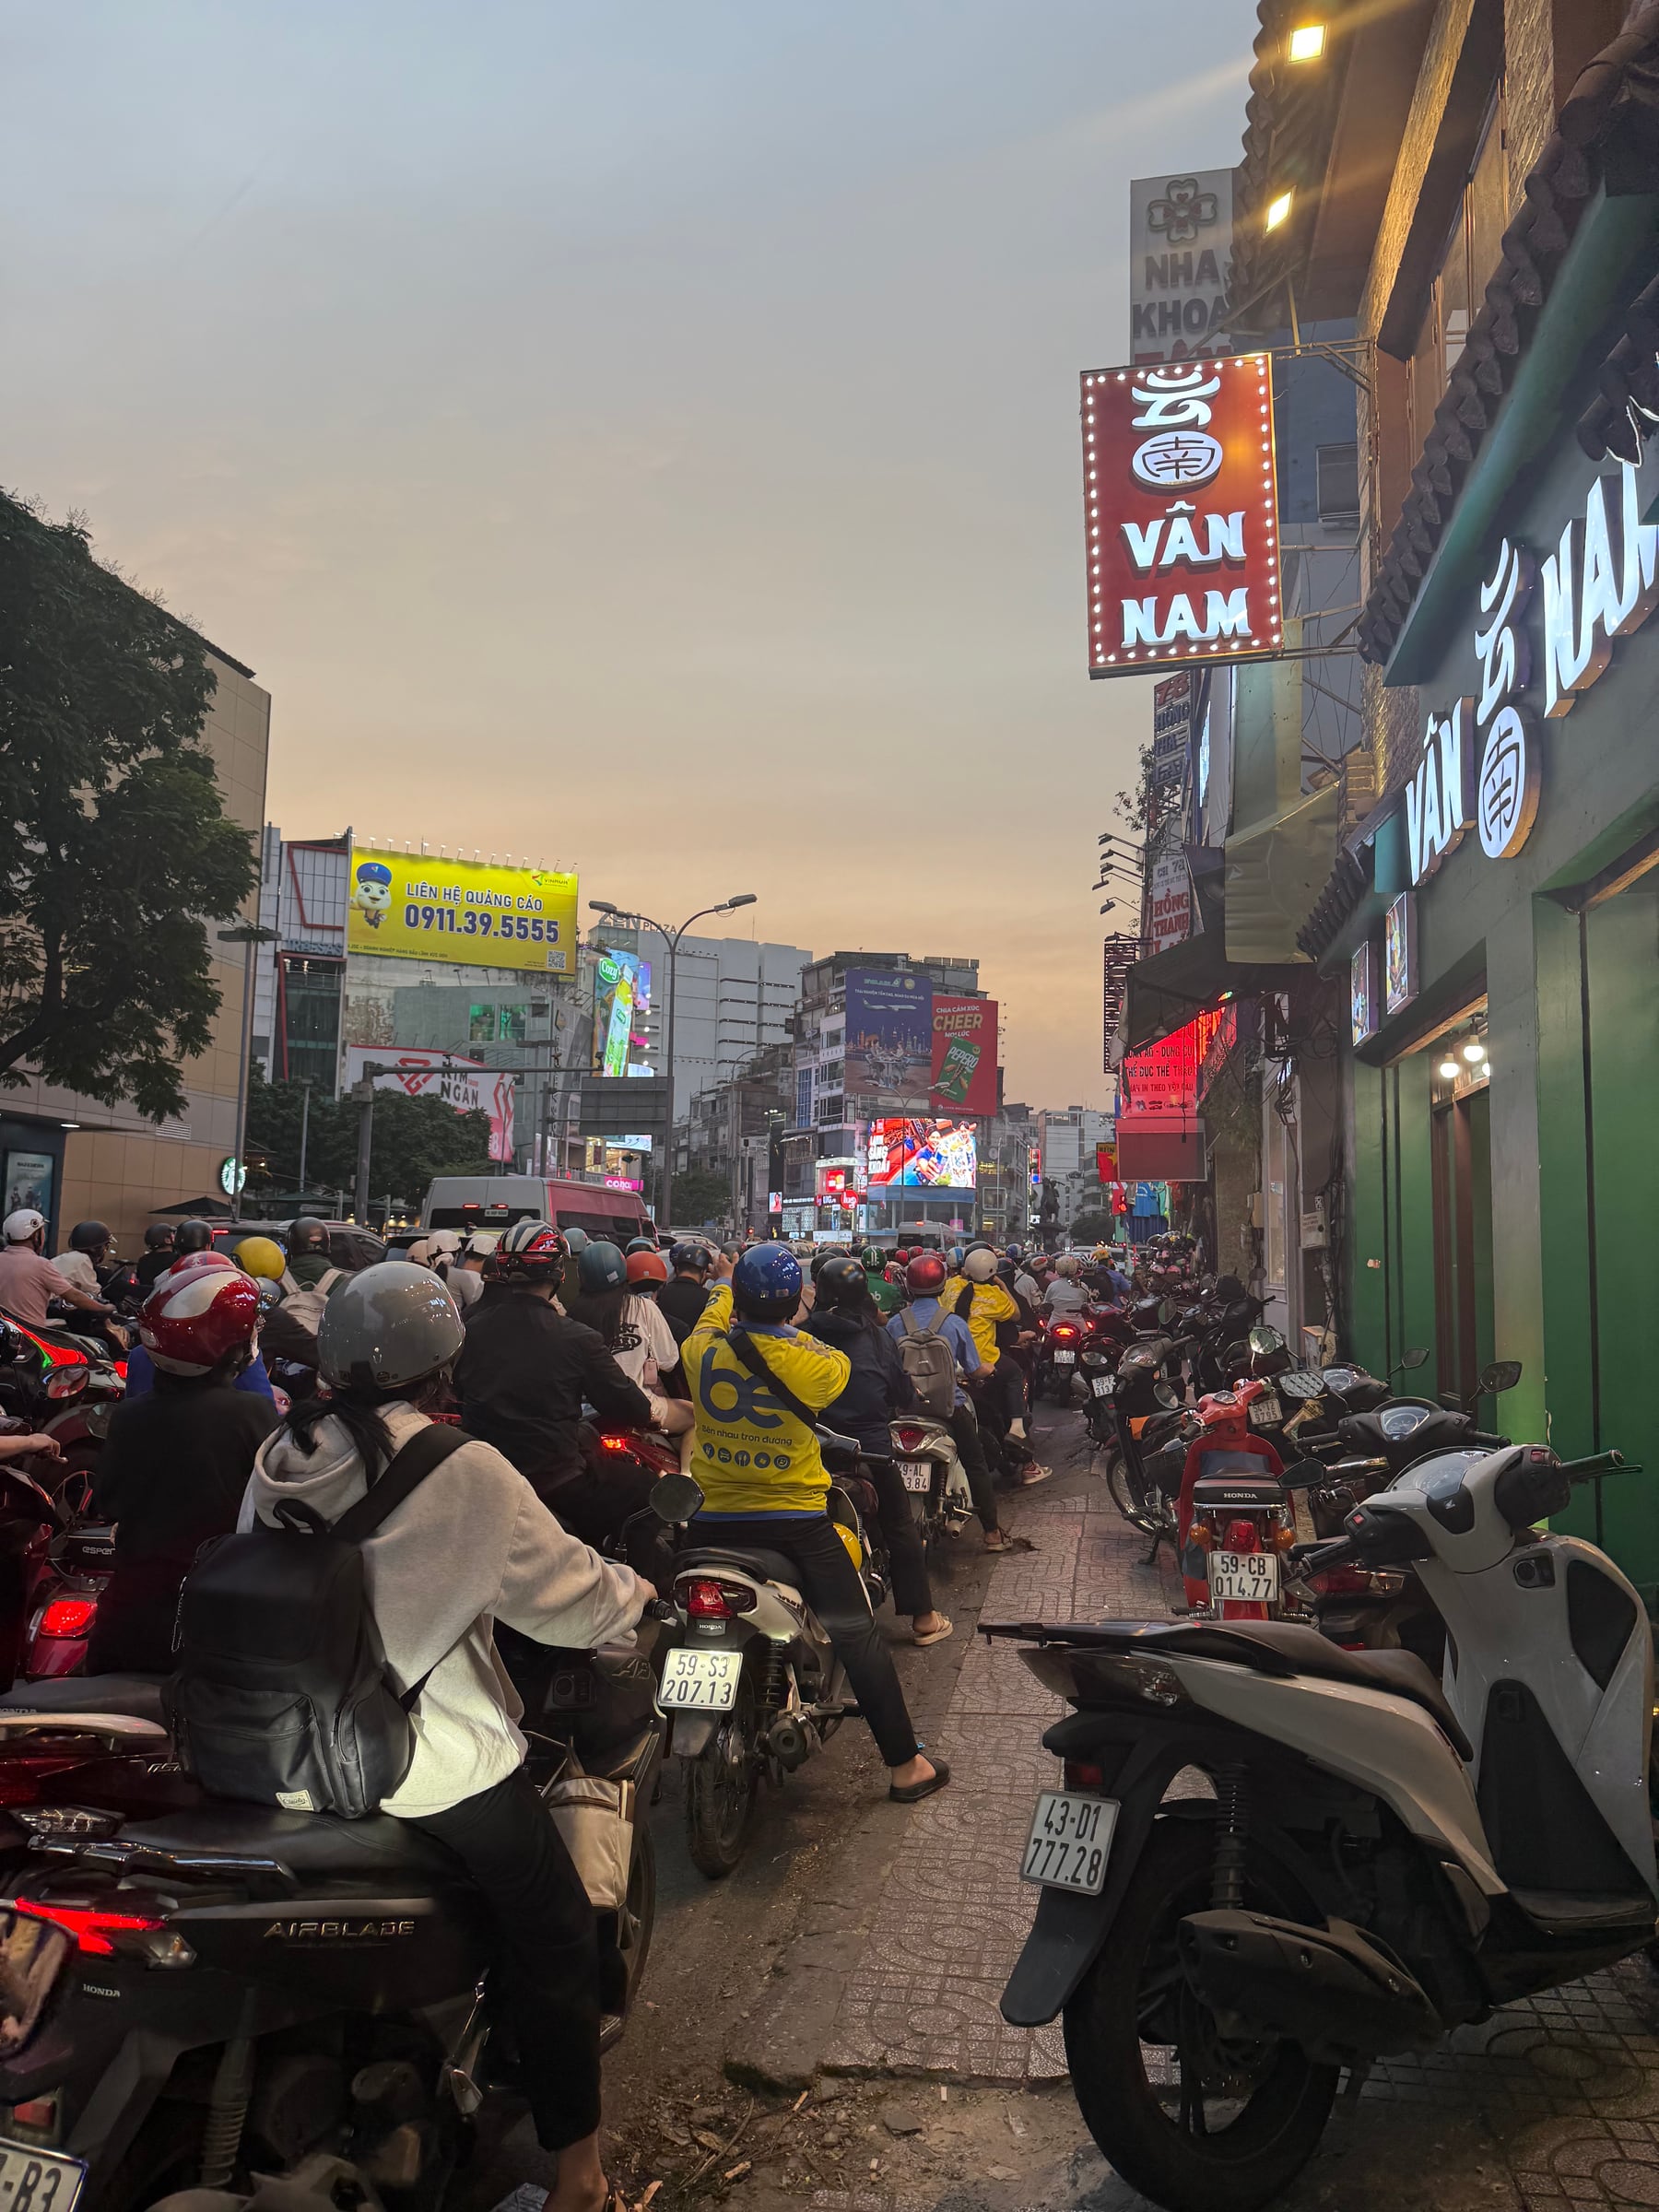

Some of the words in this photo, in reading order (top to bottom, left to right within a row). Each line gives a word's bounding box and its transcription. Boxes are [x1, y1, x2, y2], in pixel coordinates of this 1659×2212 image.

[1145, 249, 1219, 289] NHA
[1132, 295, 1229, 337] KHOA
[1120, 500, 1247, 569] VÂN
[1120, 587, 1253, 647] NAM
[406, 881, 438, 900] LIÊN
[442, 885, 461, 906] HỆ
[465, 889, 512, 908] QUẢNG
[517, 894, 543, 912] CÁO
[1154, 888, 1189, 917] HỒNG
[405, 903, 559, 944] 0911.39.5555
[643, 922, 677, 934] PLAZA
[1154, 912, 1189, 937] THANH
[601, 962, 618, 980] Cozy
[933, 1013, 983, 1031] CHEER
[947, 1046, 980, 1069] PEPERO
[1157, 1061, 1170, 1077] THỂ
[441, 1062, 468, 1085] KIM
[441, 1080, 478, 1106] NGAN
[1150, 1083, 1165, 1091] THEO
[700, 1347, 791, 1429] be
[1096, 1376, 1113, 1387] 59-F
[716, 1430, 739, 1440] nhau
[900, 1464, 924, 1477] 9-AL
[1220, 1555, 1266, 1576] 59-CB
[1215, 1576, 1272, 1598] 014.77
[676, 1653, 731, 1678] 59-S3
[663, 1679, 733, 1705] 207.13
[1043, 1798, 1102, 1842] 43-D1
[1026, 1837, 1102, 1887] 777.28
[264, 1921, 415, 1937] AIRBLADE
[82, 1983, 121, 1998] HONDA
